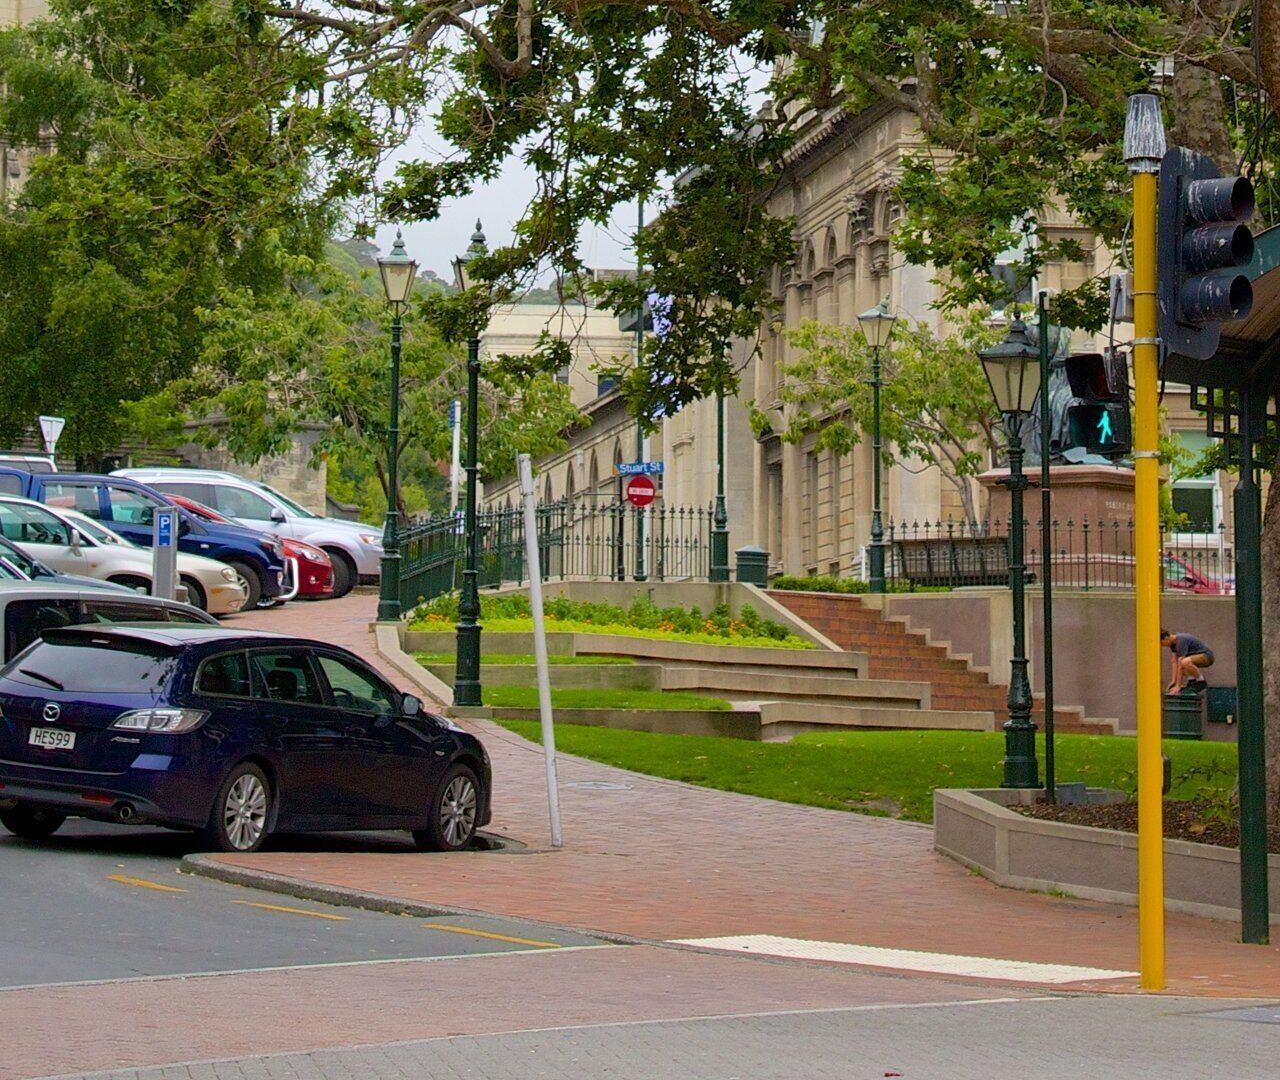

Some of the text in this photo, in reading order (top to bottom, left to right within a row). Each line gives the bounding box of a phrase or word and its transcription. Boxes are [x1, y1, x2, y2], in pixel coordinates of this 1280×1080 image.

[620, 462, 661, 473] Stuart St
[160, 516, 170, 529] P
[33, 729, 71, 746] HES99
